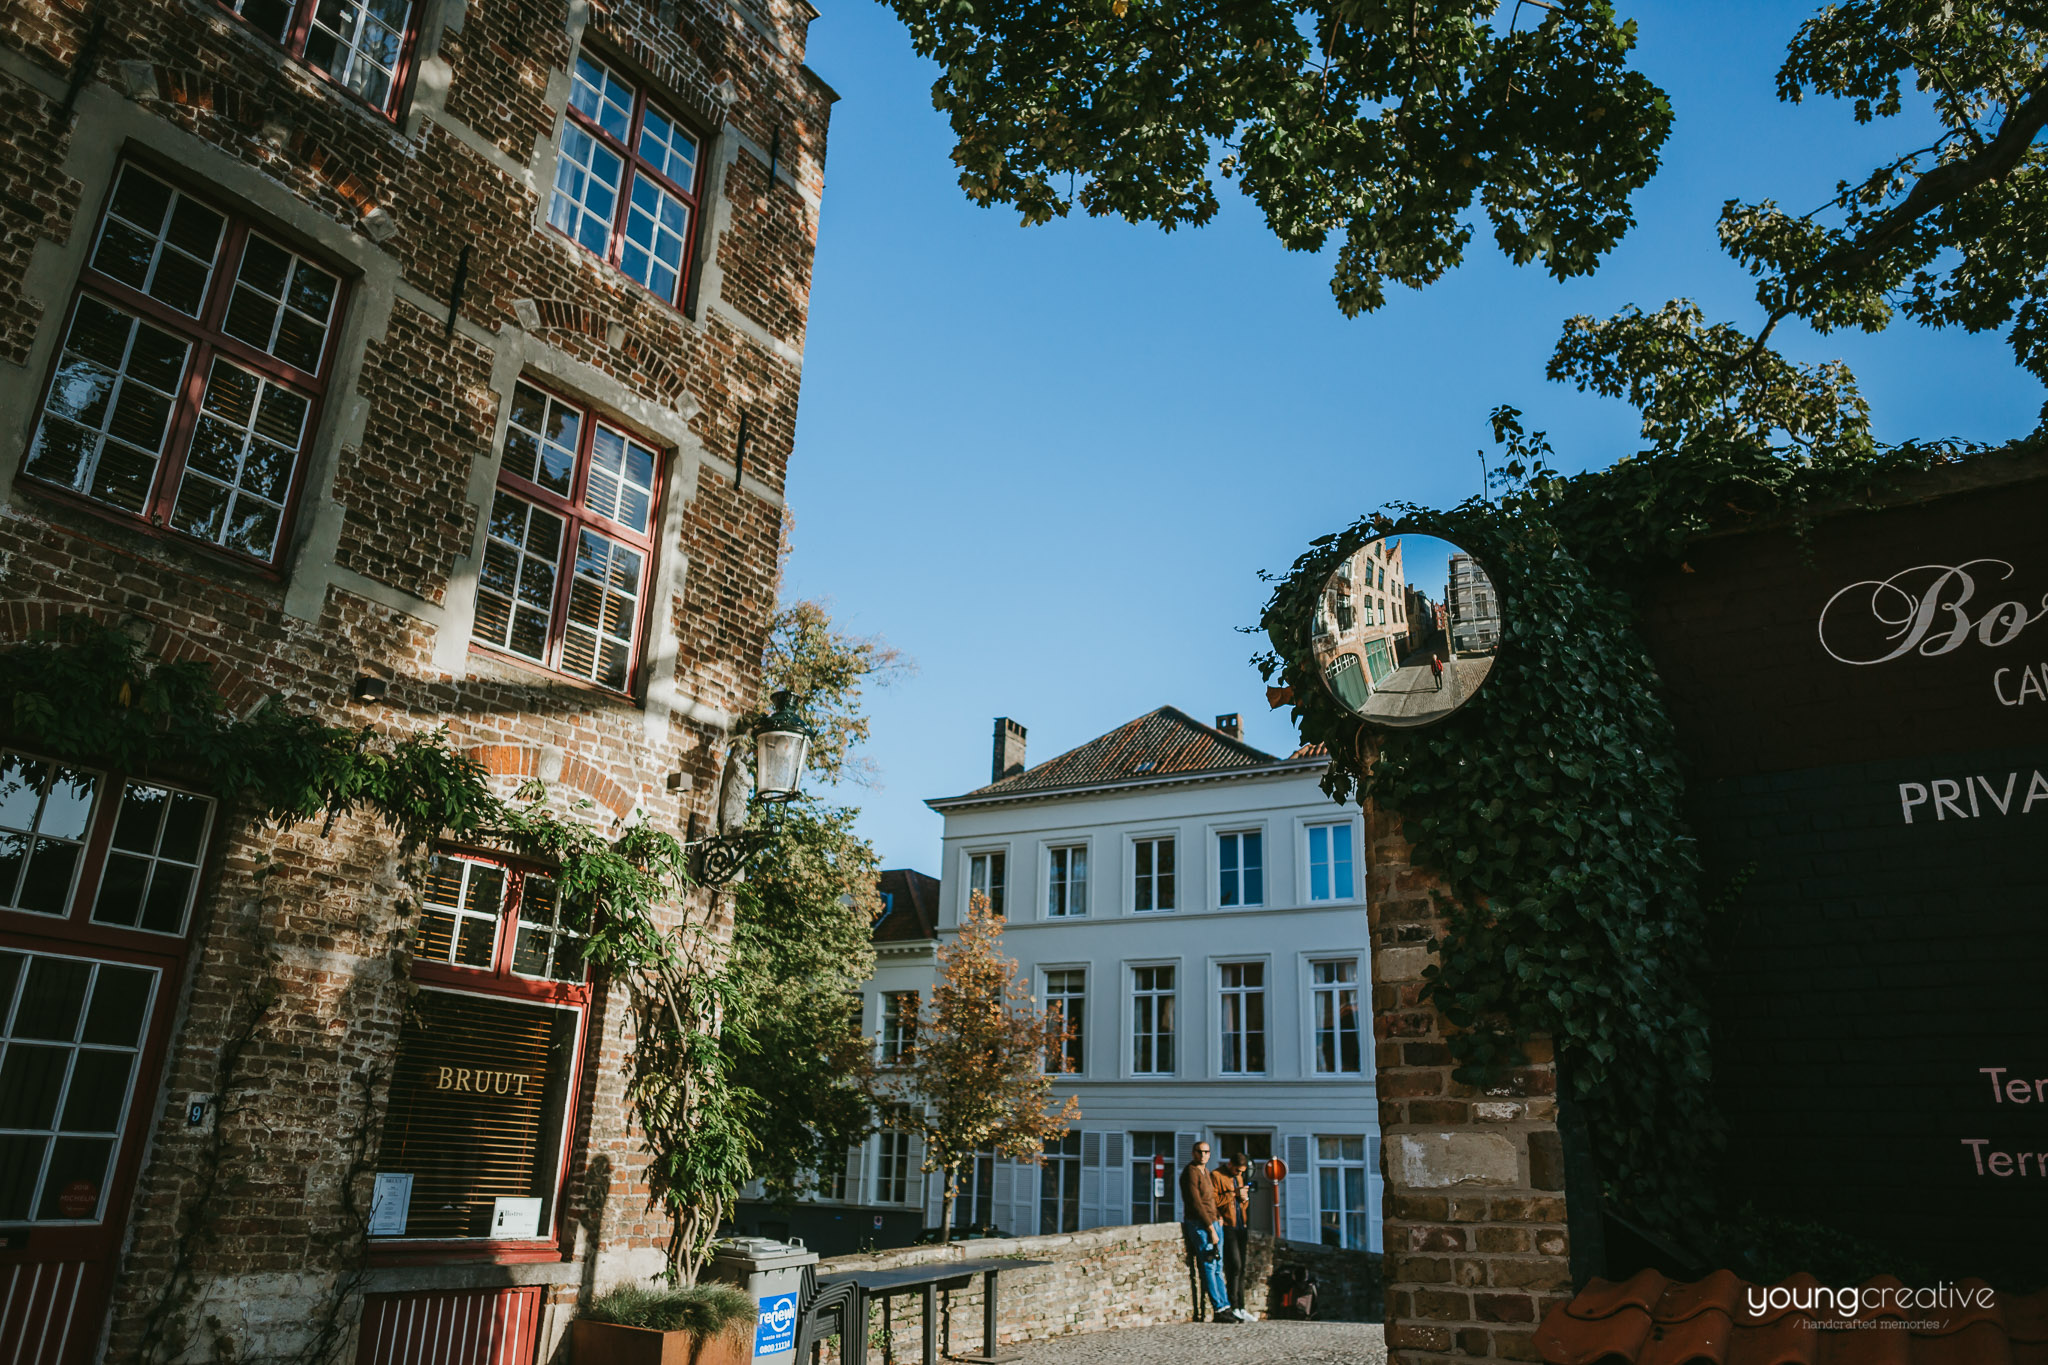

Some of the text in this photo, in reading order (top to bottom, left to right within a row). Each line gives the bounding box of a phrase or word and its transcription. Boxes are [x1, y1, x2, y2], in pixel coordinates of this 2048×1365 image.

[1819, 558, 2048, 665] Bo
[1898, 769, 2048, 824] PRIVA
[436, 1066, 530, 1096] BRUUT
[1979, 1067, 2048, 1104] Ter
[191, 1106, 201, 1122] 9
[1961, 1138, 2048, 1177] Terr
[60, 1194, 96, 1202] MICHELIN
[759, 1304, 795, 1326] renewi
[759, 1343, 775, 1354] 0800
